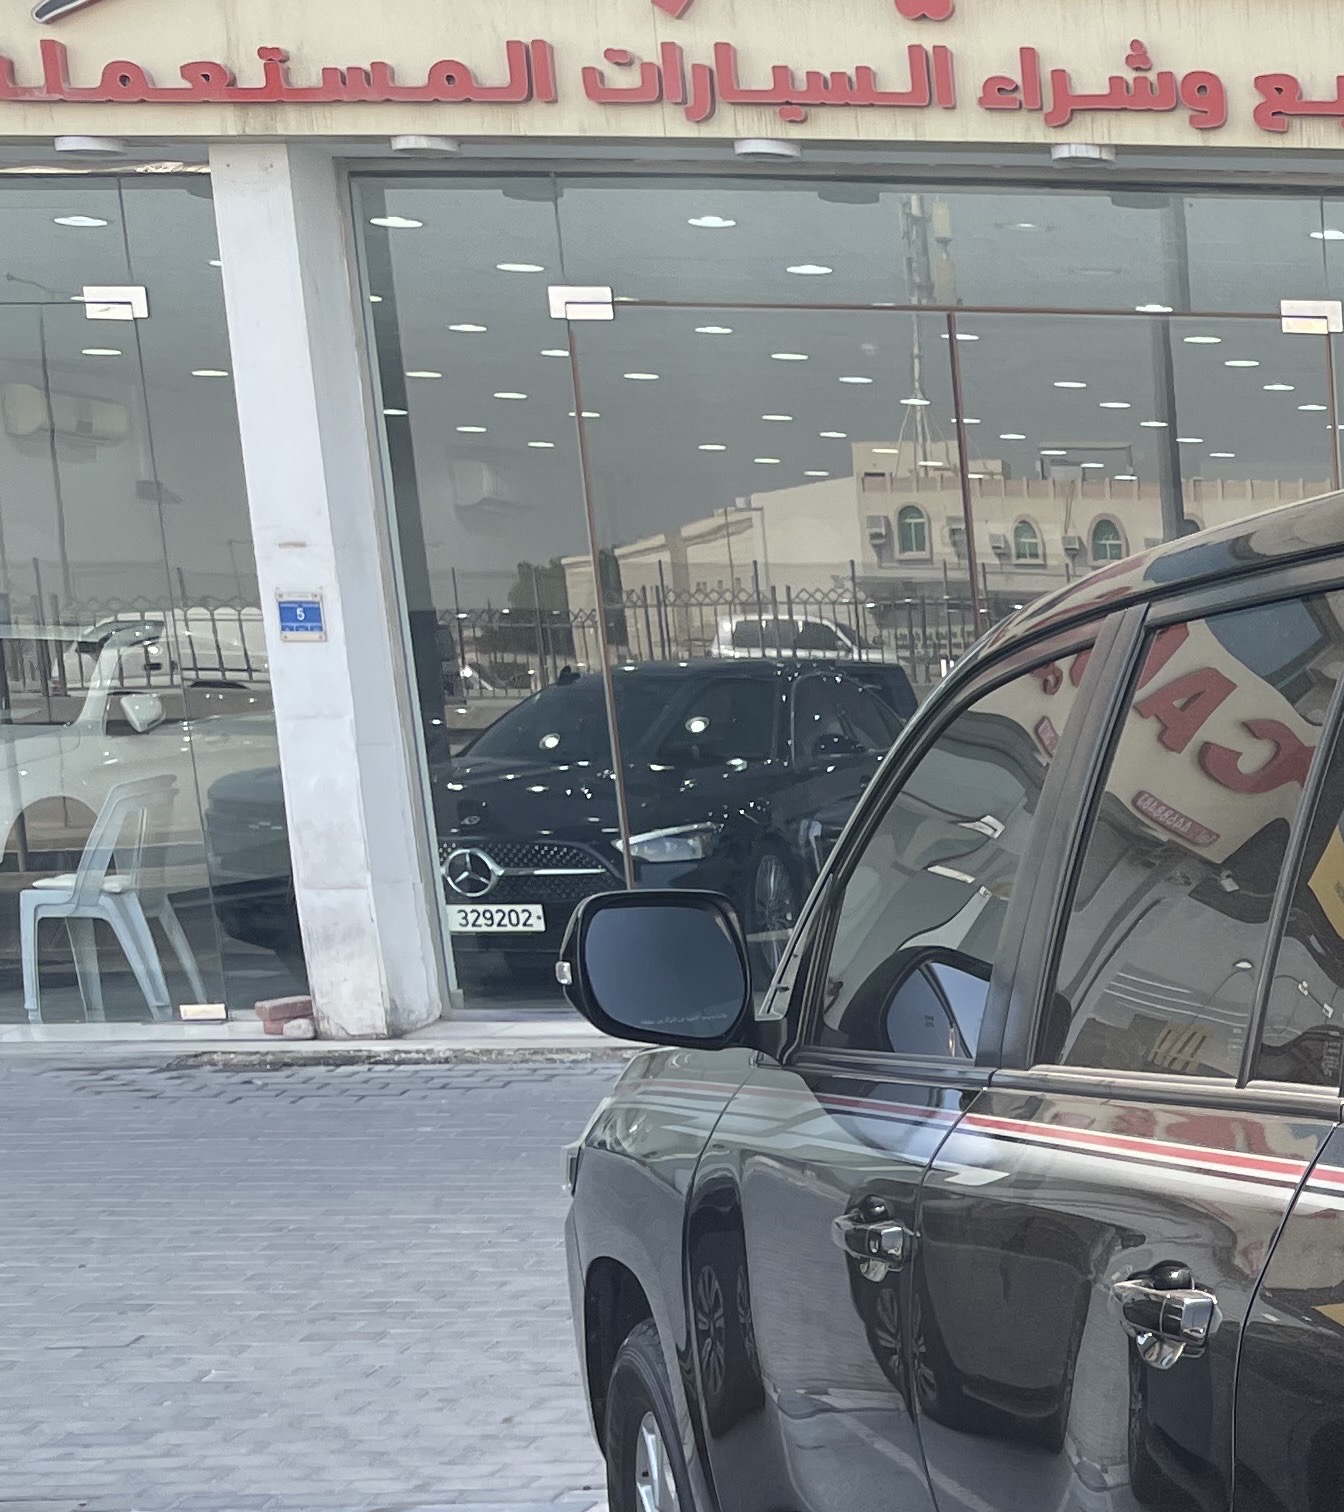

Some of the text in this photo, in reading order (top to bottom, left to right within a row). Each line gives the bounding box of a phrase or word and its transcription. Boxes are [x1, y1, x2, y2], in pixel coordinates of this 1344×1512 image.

[582, 40, 955, 123] السيارات
[977, 39, 1228, 130] وشراء
[457, 909, 534, 927] 329202
